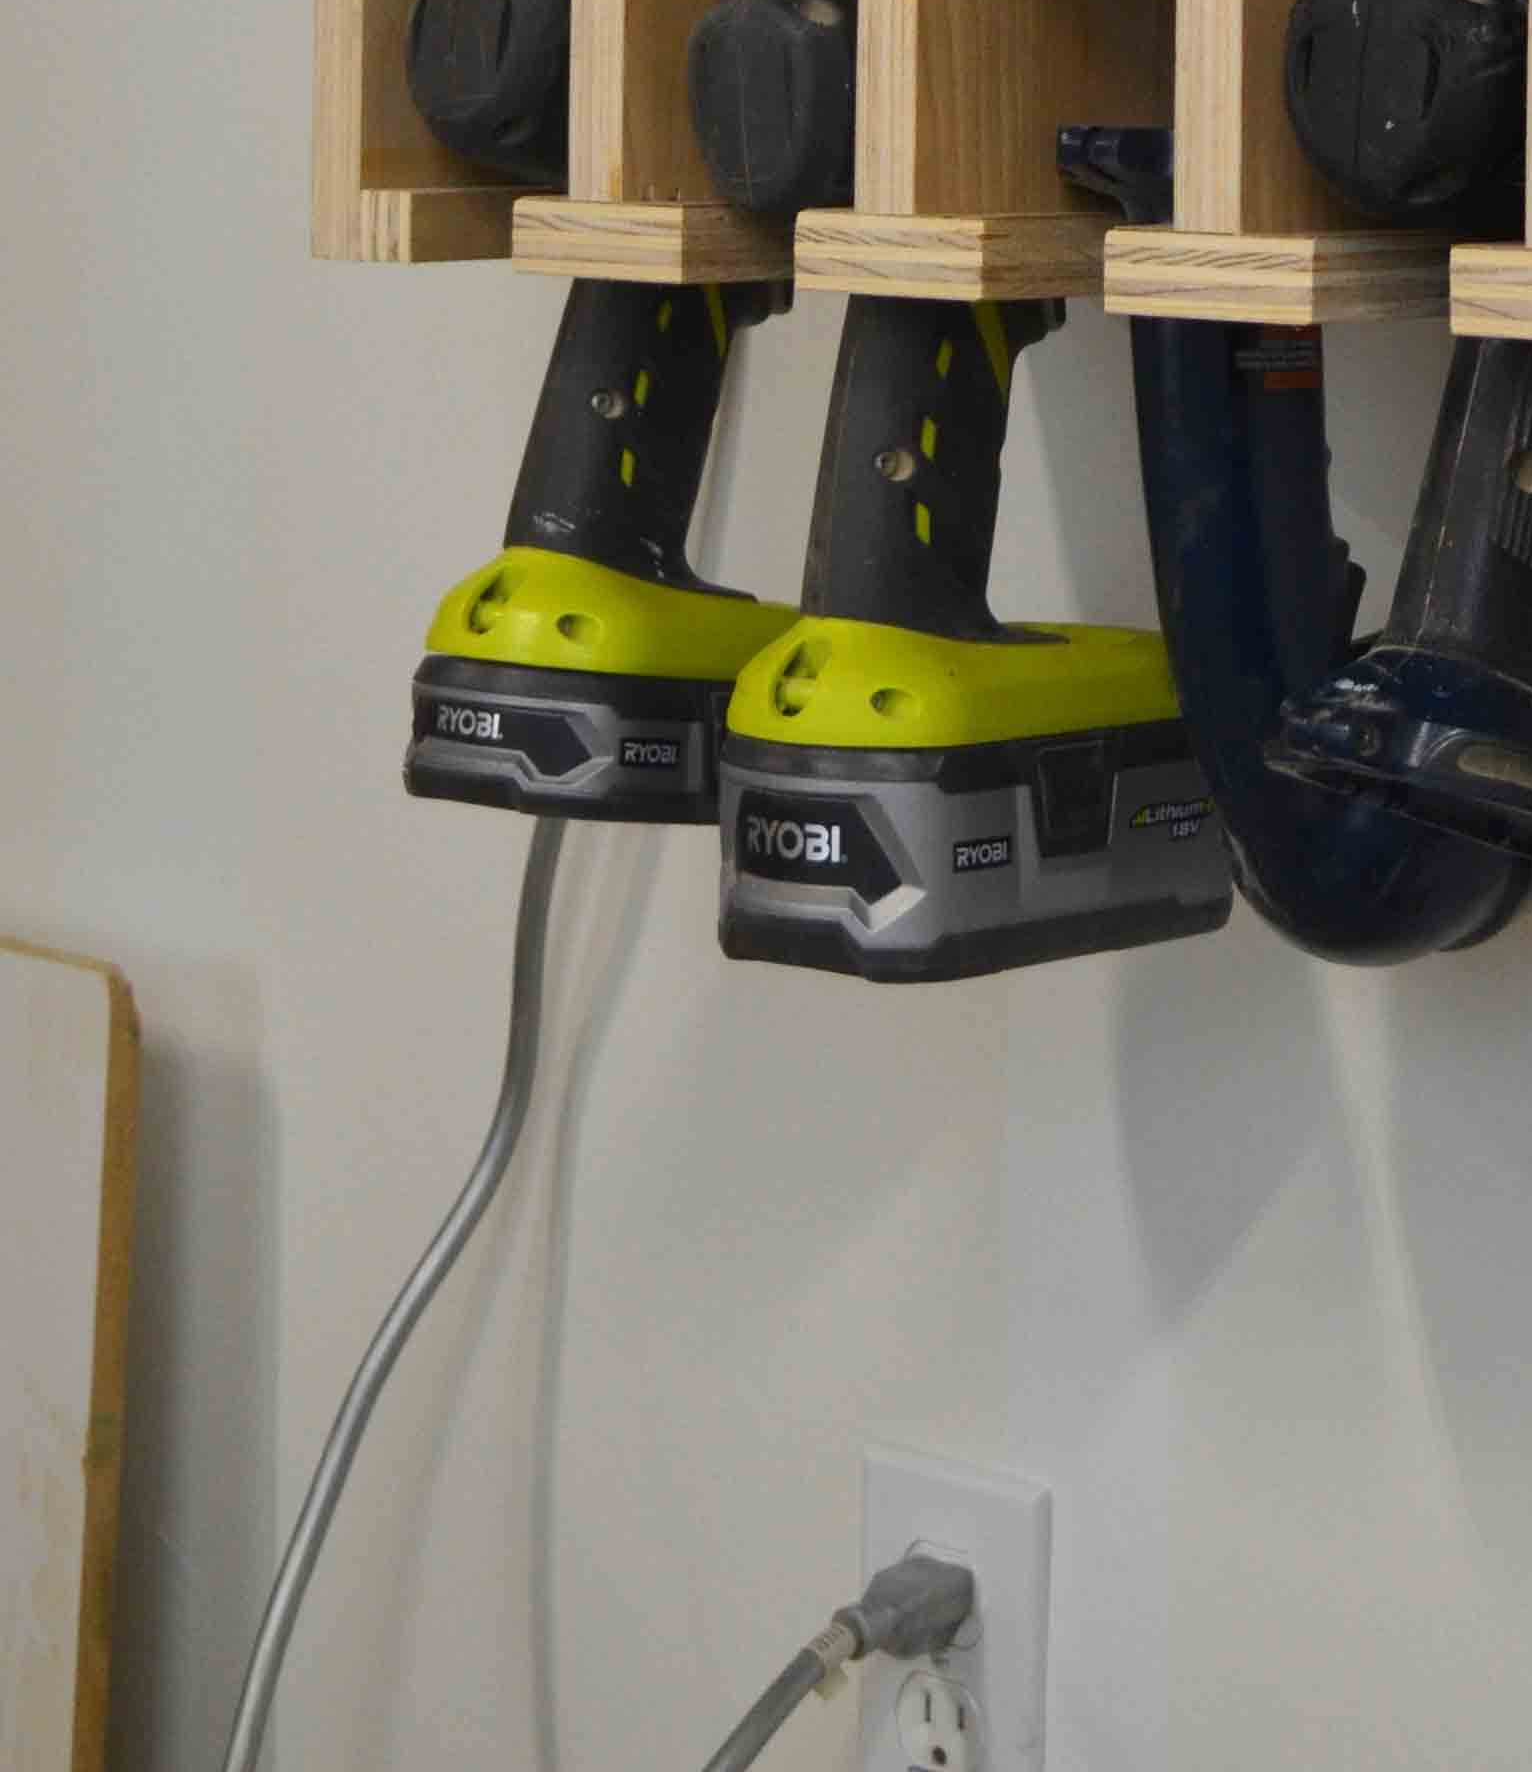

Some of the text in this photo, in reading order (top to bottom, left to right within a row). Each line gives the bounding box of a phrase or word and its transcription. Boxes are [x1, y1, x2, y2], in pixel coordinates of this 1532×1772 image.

[436, 705, 500, 739] RYOBI
[623, 742, 677, 763] RYOBI
[746, 815, 842, 863] RYOBI
[1172, 820, 1199, 837] 18V
[956, 841, 1008, 867] RYOBI
